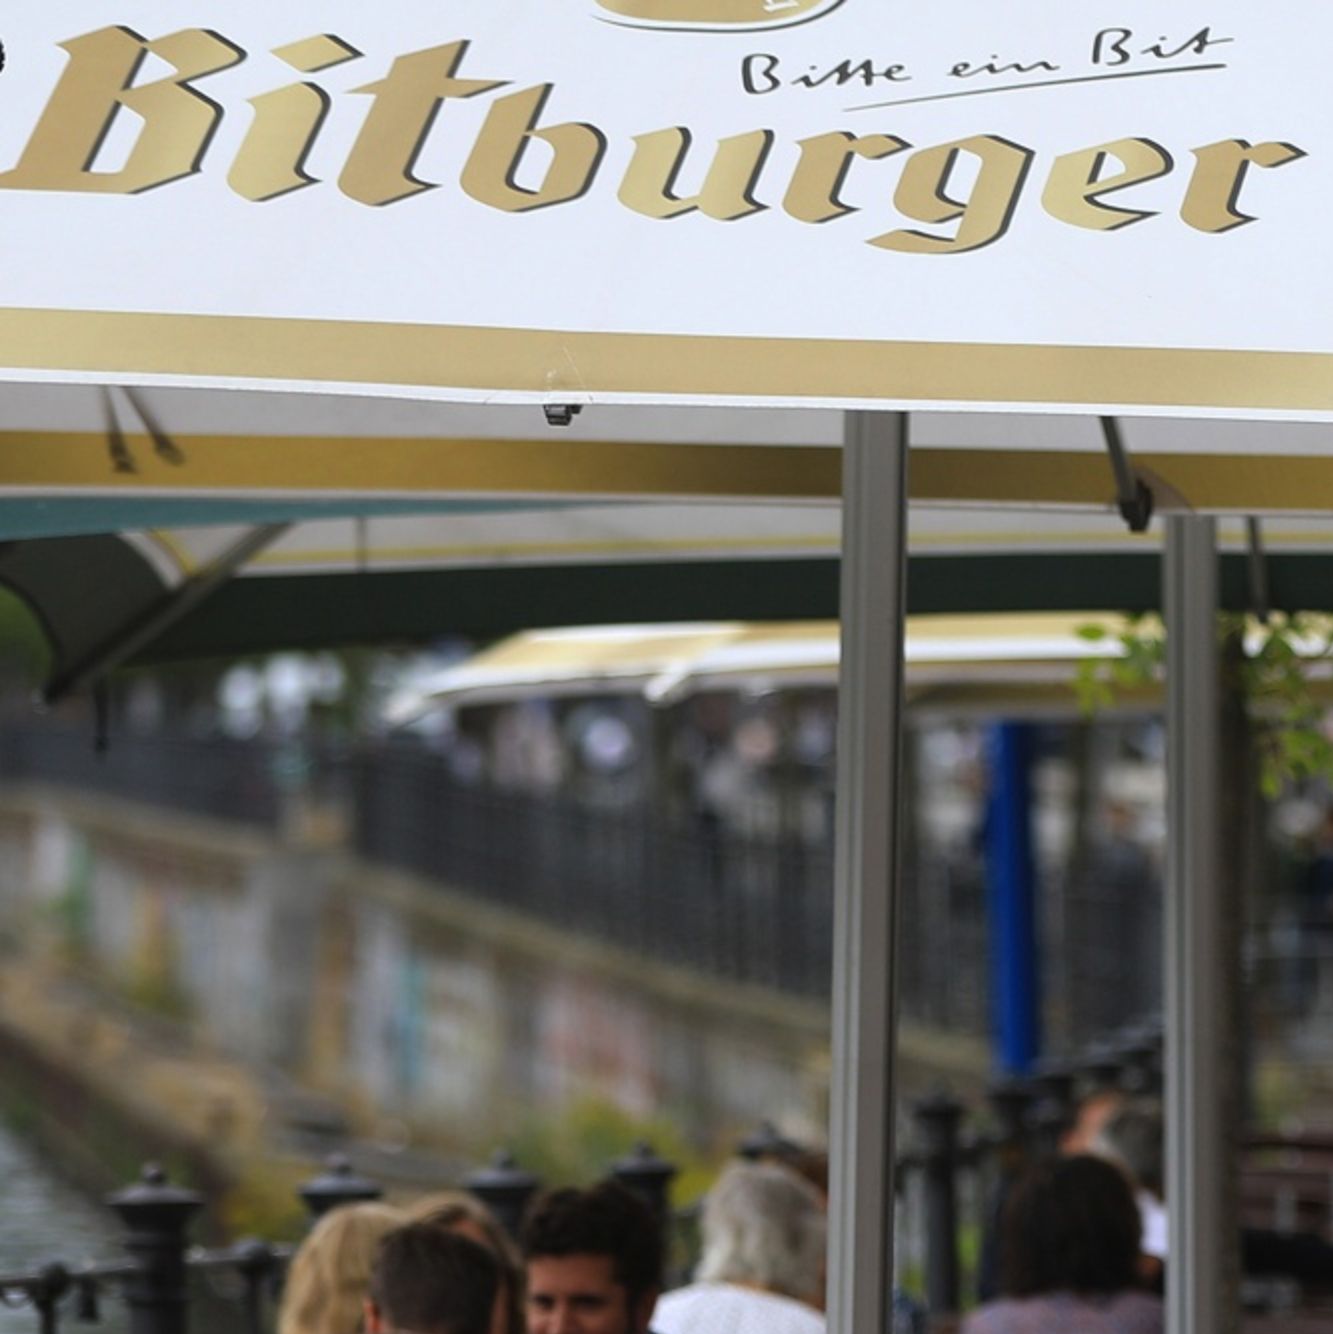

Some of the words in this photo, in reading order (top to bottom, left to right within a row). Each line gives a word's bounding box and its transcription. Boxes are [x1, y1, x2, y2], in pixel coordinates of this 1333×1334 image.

[742, 53, 912, 95] Bitte
[946, 54, 1060, 79] ein
[1091, 26, 1236, 66] Bit
[0, 24, 1307, 255] Bitburger
